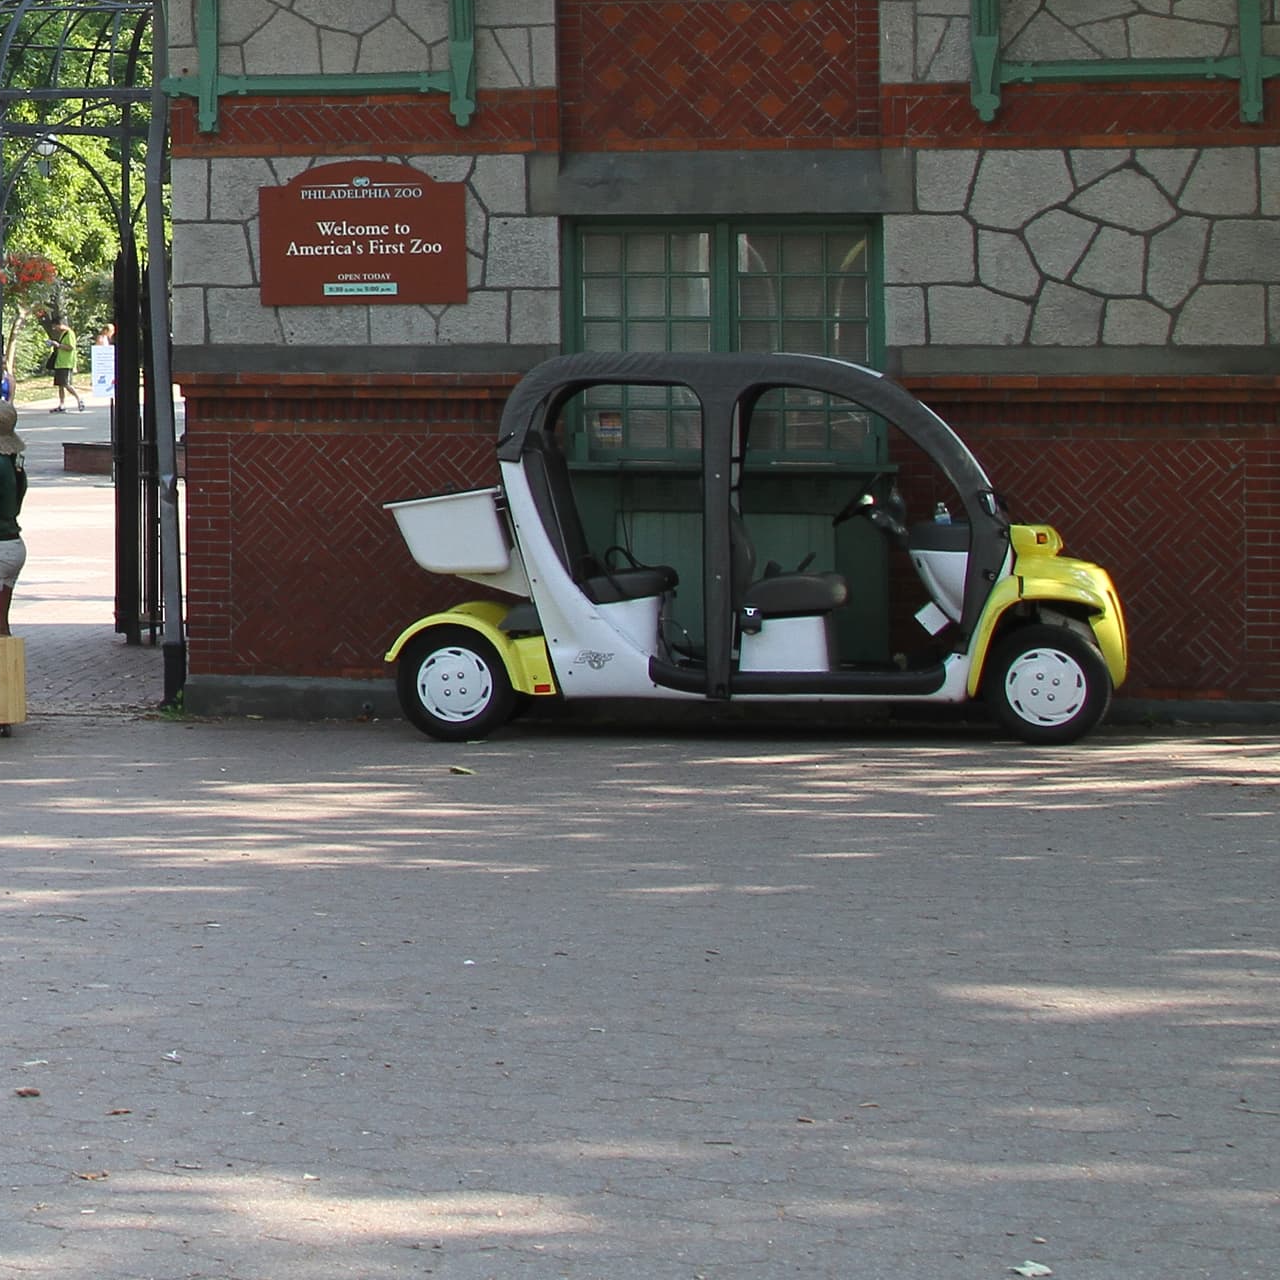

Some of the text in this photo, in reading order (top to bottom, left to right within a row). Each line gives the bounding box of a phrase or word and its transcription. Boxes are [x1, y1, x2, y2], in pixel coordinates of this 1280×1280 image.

[300, 187, 423, 200] PHILADELPHIA ZOO
[315, 220, 411, 237] Welcome to
[286, 238, 443, 257] America's First Zoo
[337, 272, 392, 281] OPEN TODAY
